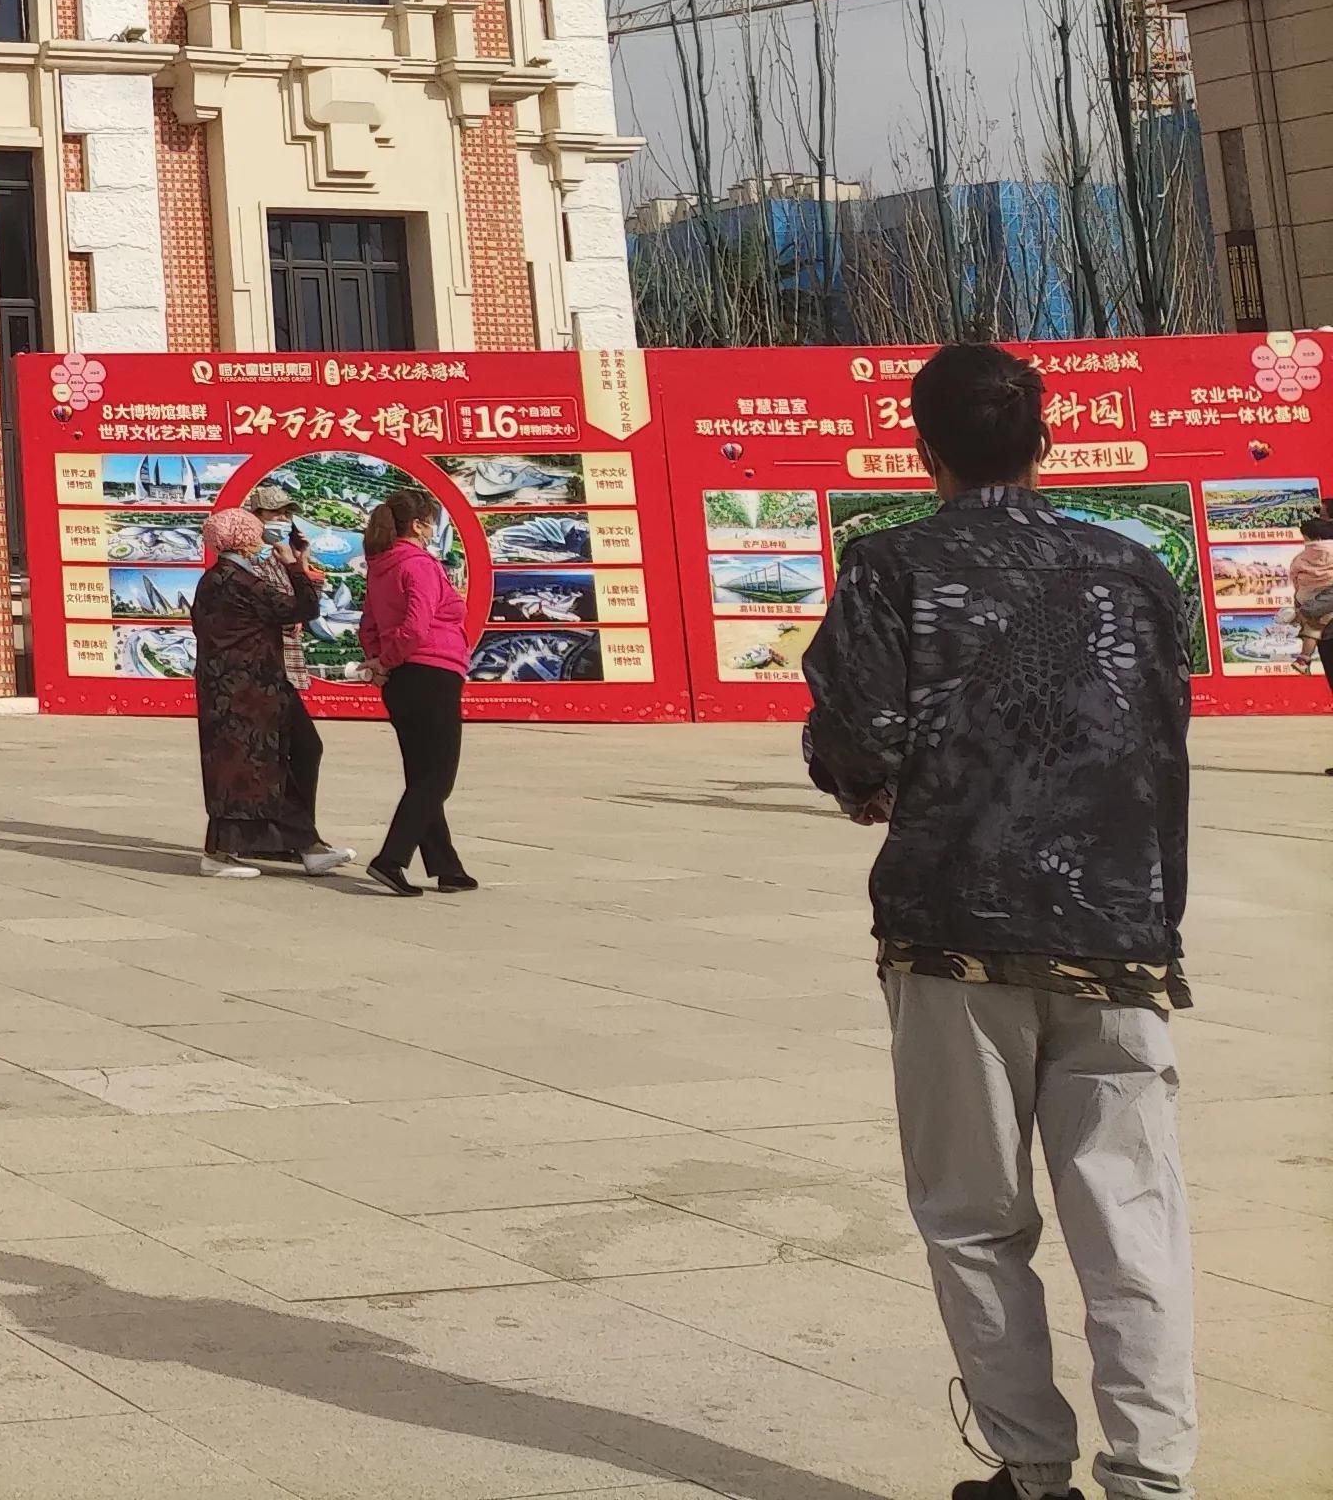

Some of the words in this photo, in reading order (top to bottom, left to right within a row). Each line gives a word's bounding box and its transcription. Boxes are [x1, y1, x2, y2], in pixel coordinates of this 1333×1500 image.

[340, 361, 470, 383] 恒大文化旅游城
[879, 359, 929, 374] 恒大童
[1029, 352, 1143, 375] 大文化旅游城
[1191, 386, 1263, 405] 农业中心
[102, 403, 208, 421] 8大博物馆集群
[736, 398, 808, 415] 智慧温室
[233, 400, 444, 446] 24万方文博园
[475, 405, 518, 438] 16
[1149, 405, 1311, 428] 生产观光一体化基地
[98, 423, 223, 442] 世界文化艺术殿堂
[695, 418, 855, 436] 现代化农业生产典范
